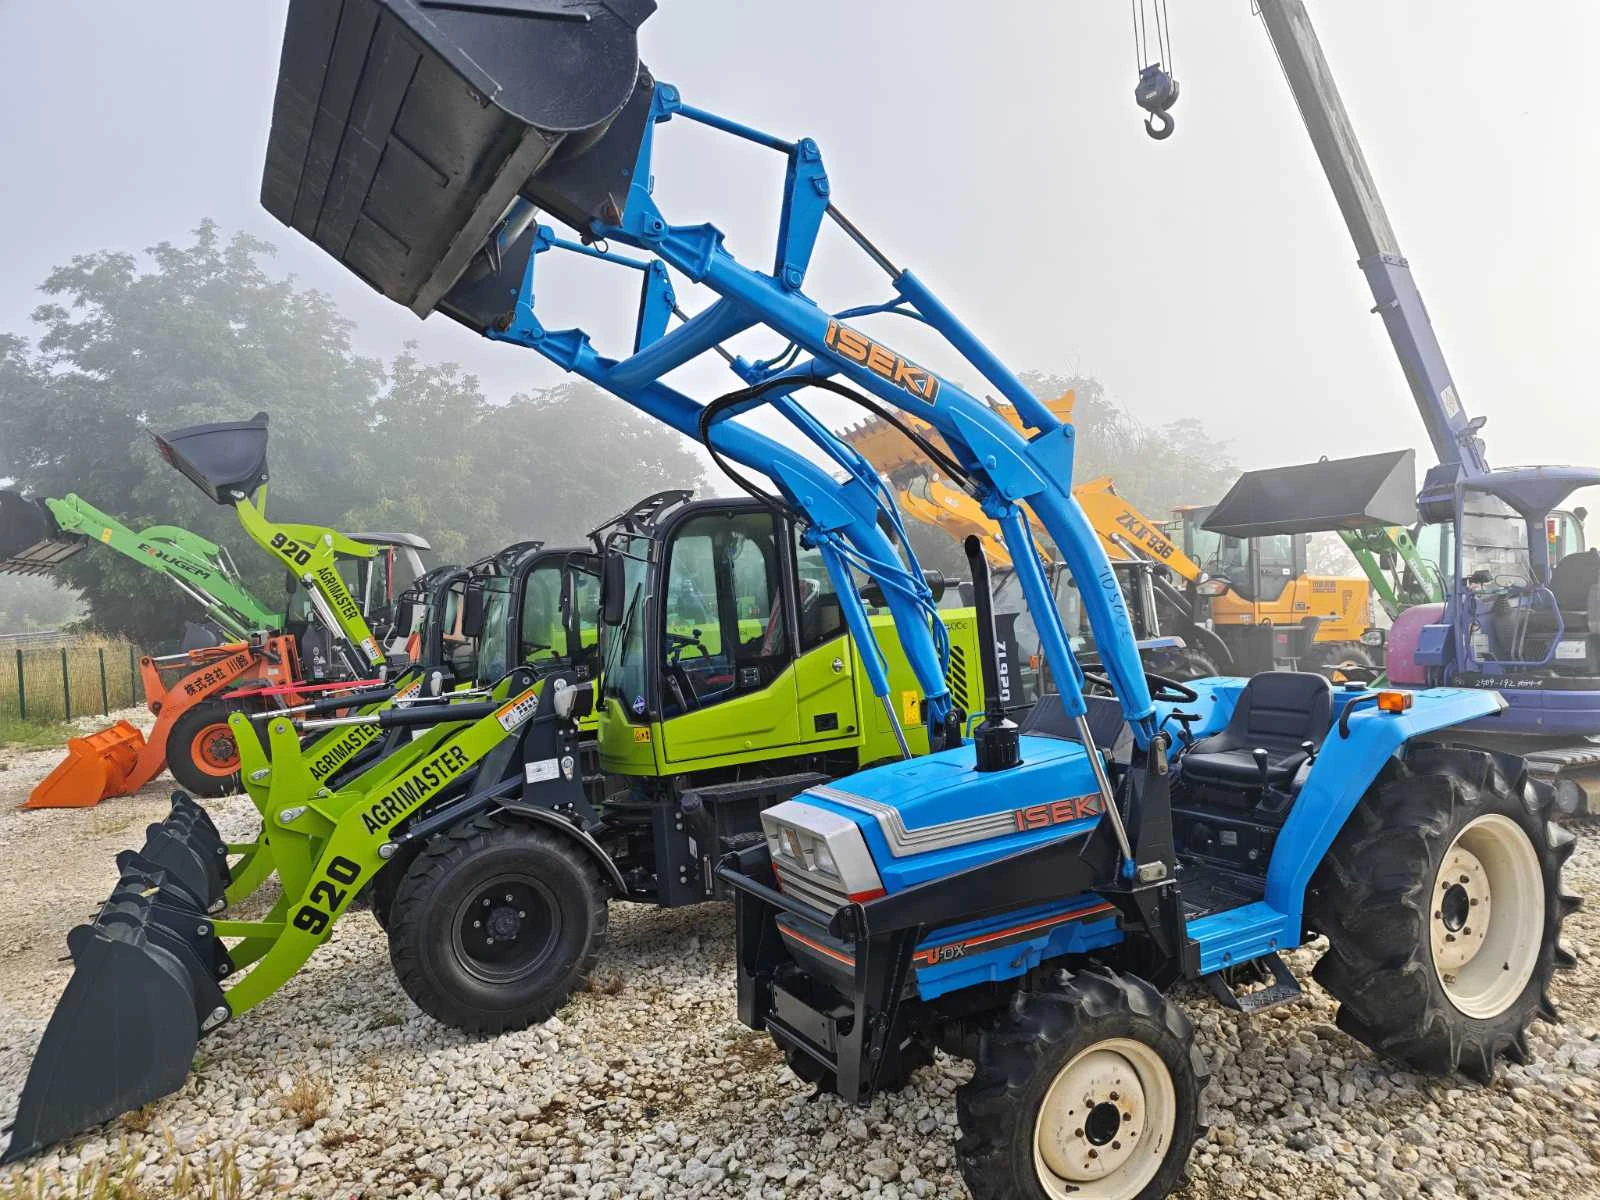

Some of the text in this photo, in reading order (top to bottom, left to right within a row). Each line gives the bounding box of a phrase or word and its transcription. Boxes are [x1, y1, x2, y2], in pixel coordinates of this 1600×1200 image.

[825, 319, 938, 403] ISEKI
[270, 532, 312, 566] 920
[316, 567, 358, 620] AGRIMASTER
[360, 745, 470, 835] AGRIMASTER
[1014, 793, 1107, 832] ISEKI
[292, 855, 362, 936] 920
